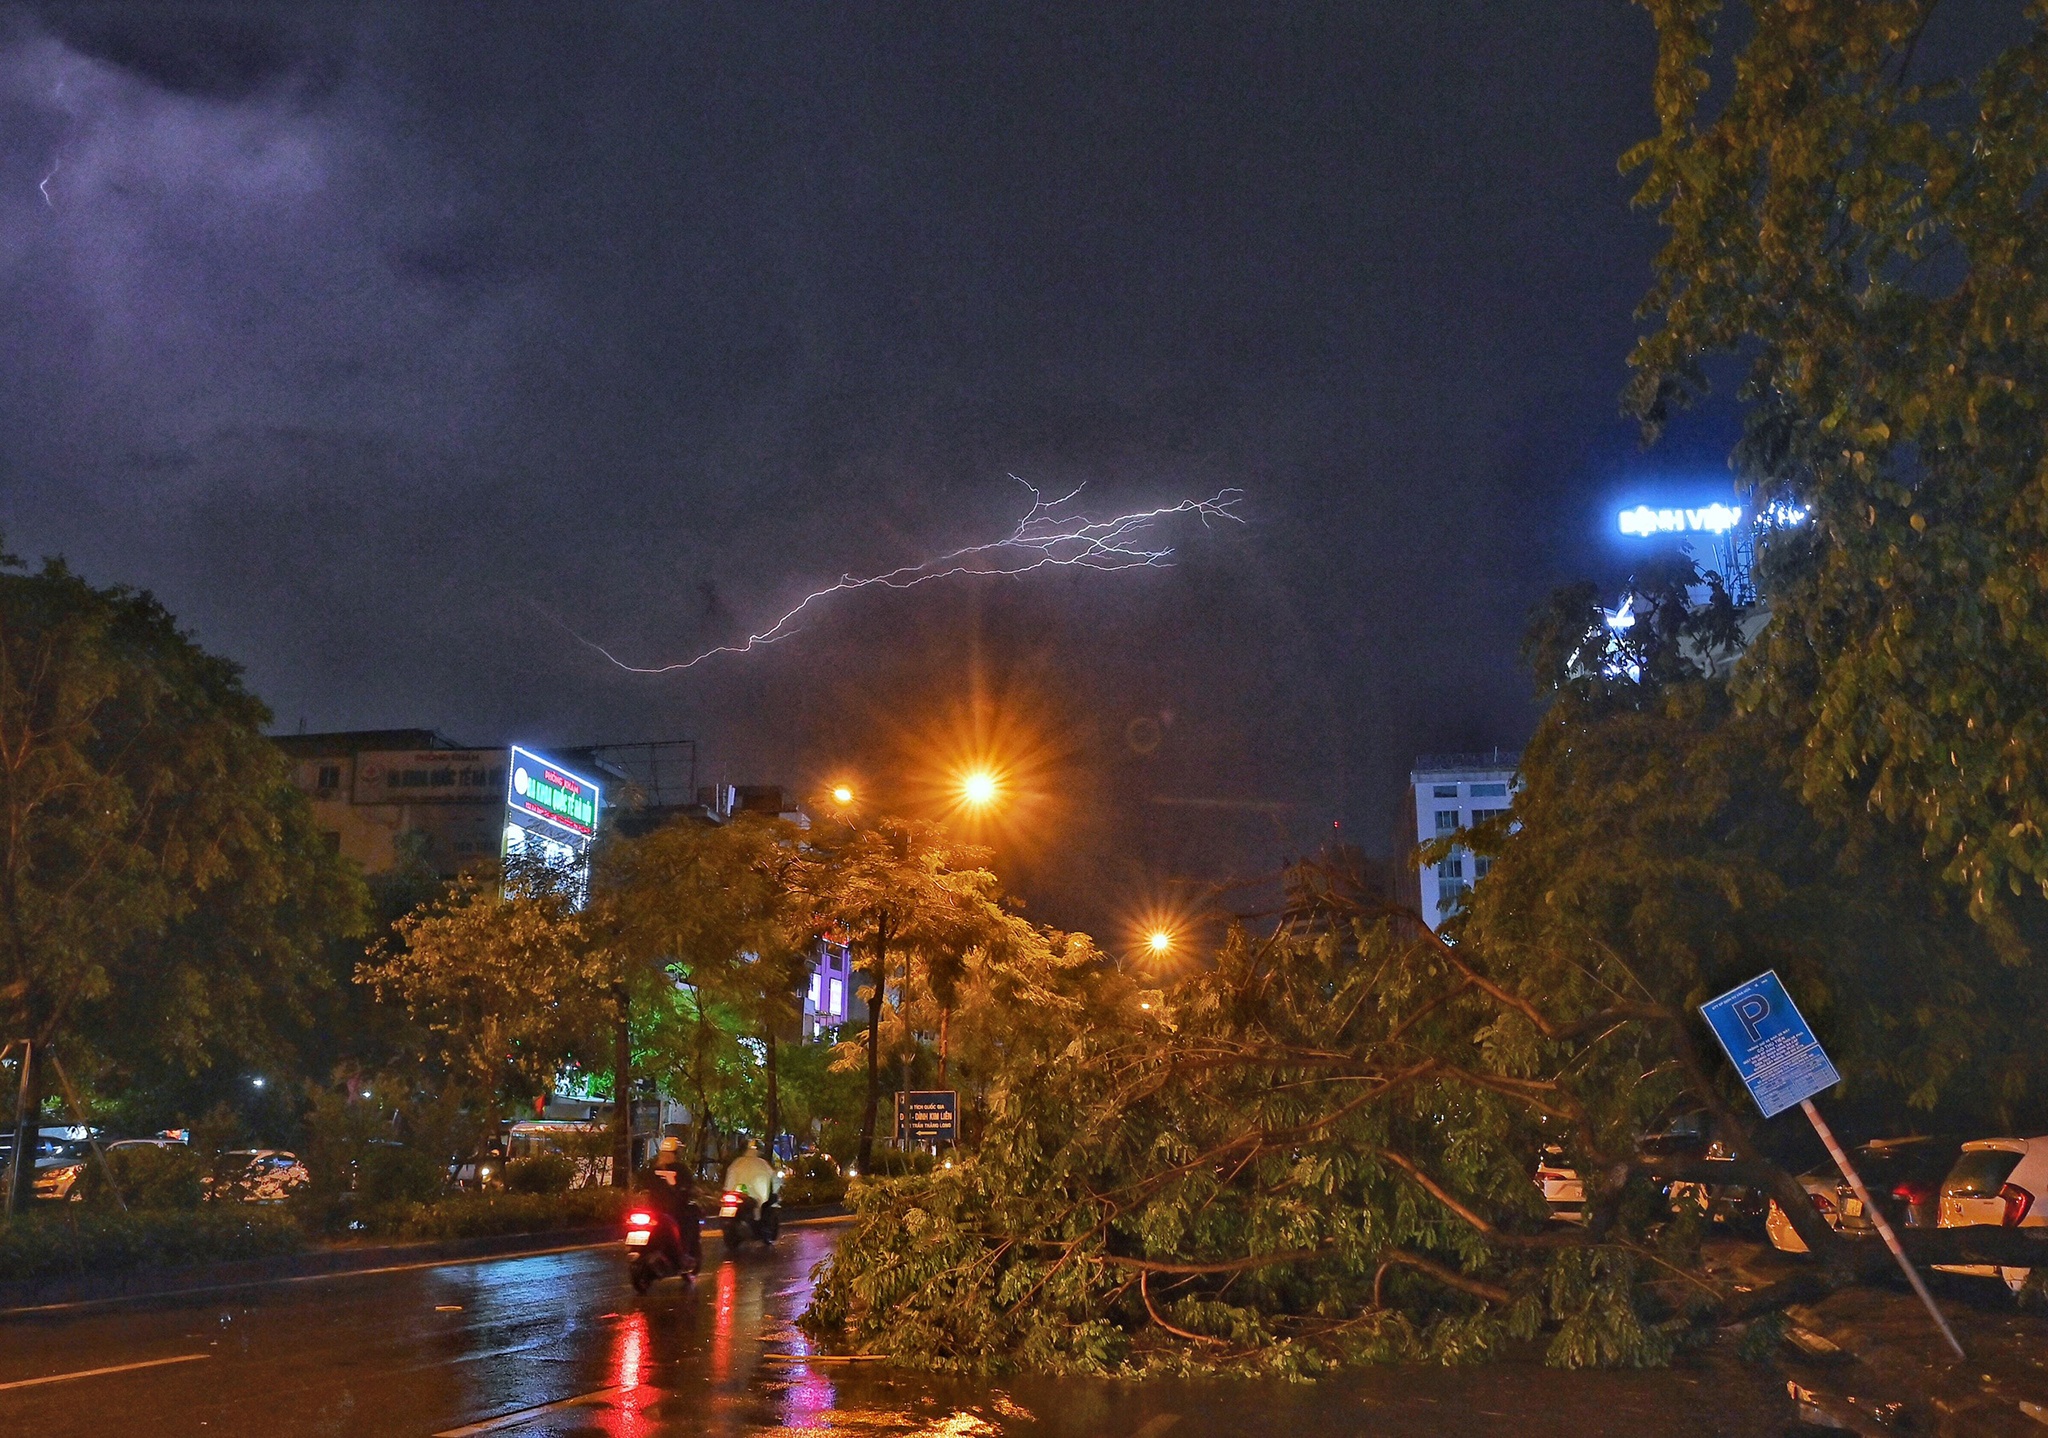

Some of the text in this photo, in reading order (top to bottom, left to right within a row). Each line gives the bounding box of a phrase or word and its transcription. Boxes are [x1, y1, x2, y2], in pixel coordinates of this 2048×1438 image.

[1732, 994, 1770, 1042] P
[915, 1111, 928, 1120] ĐÌNH
[940, 1110, 952, 1120] LIÊN
